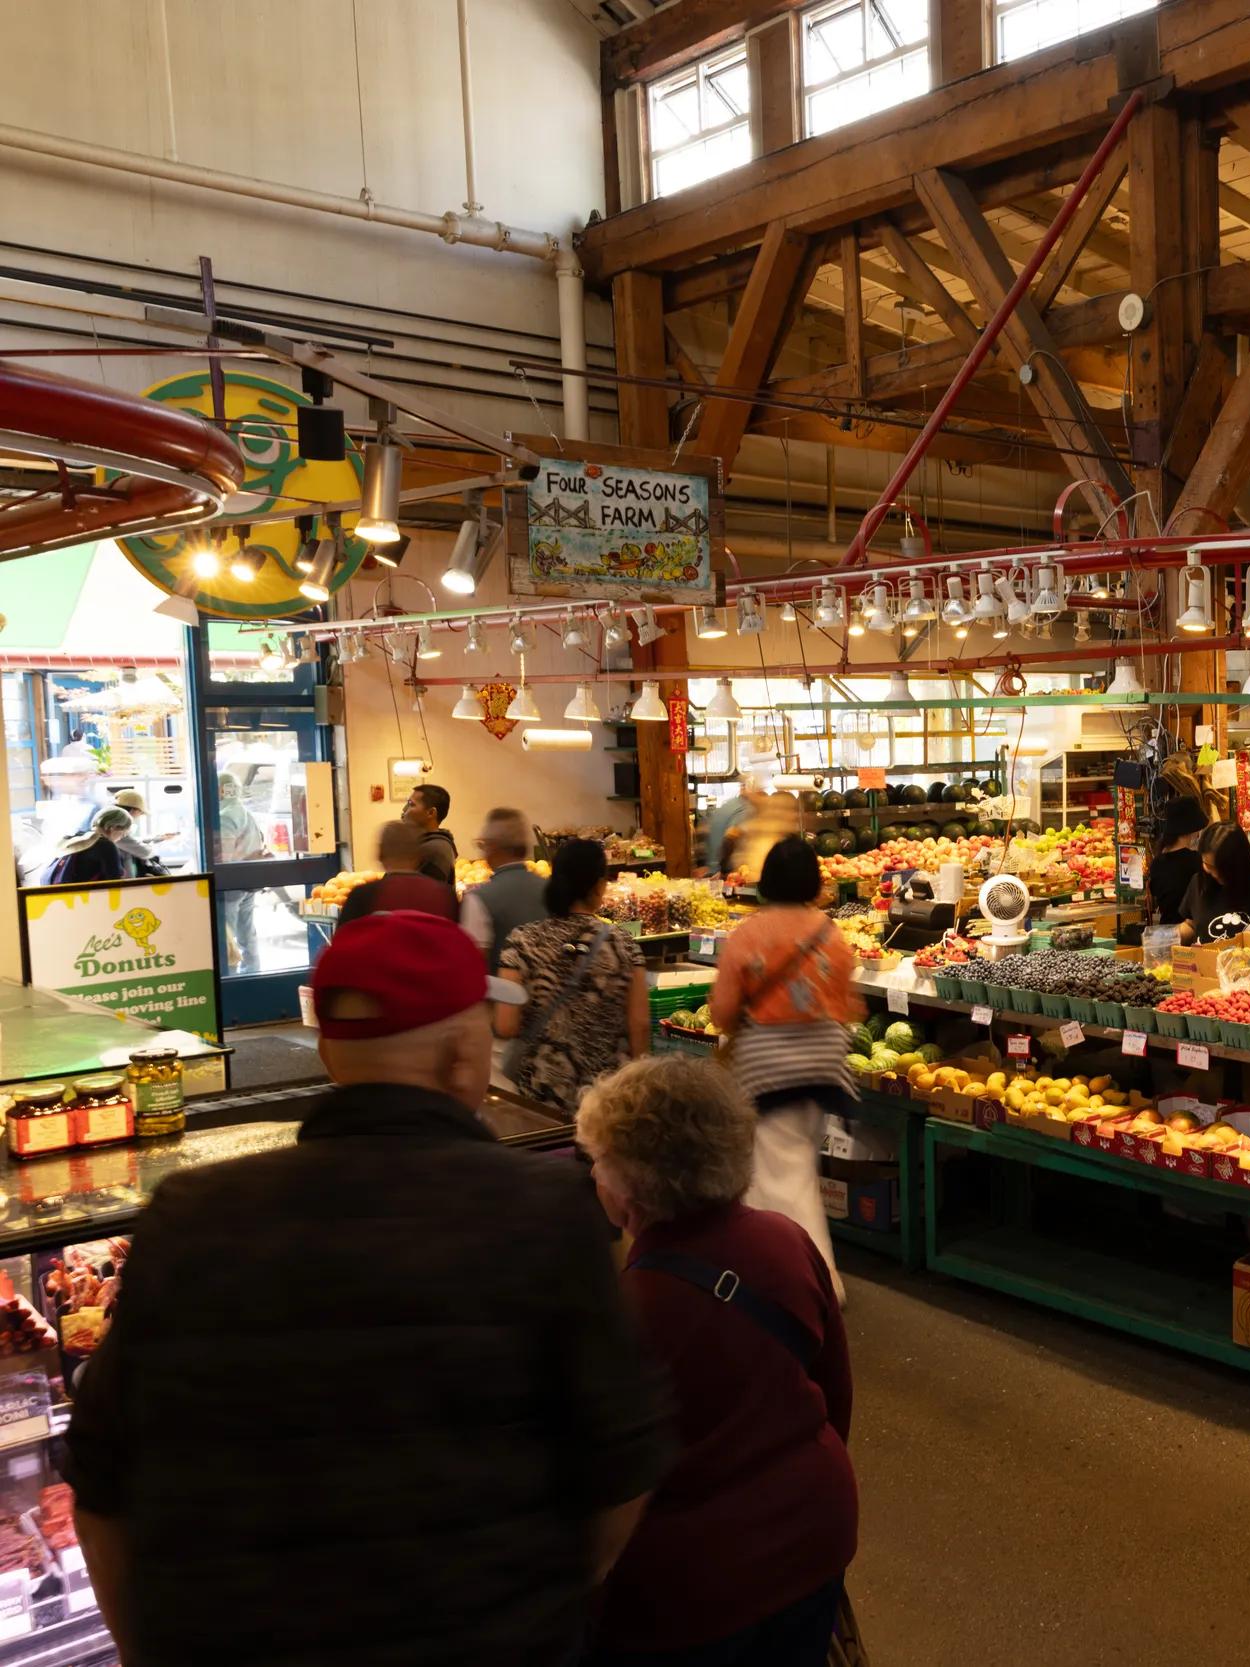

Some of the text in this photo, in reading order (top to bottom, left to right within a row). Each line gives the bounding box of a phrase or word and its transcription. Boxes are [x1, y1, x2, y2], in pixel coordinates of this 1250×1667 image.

[601, 476, 691, 504] SEASONS
[601, 505, 657, 529] FARM
[77, 933, 122, 960] Lee's
[74, 953, 177, 978] Donuts
[121, 984, 154, 1001] join
[157, 982, 187, 994] our
[176, 995, 208, 1008] line
